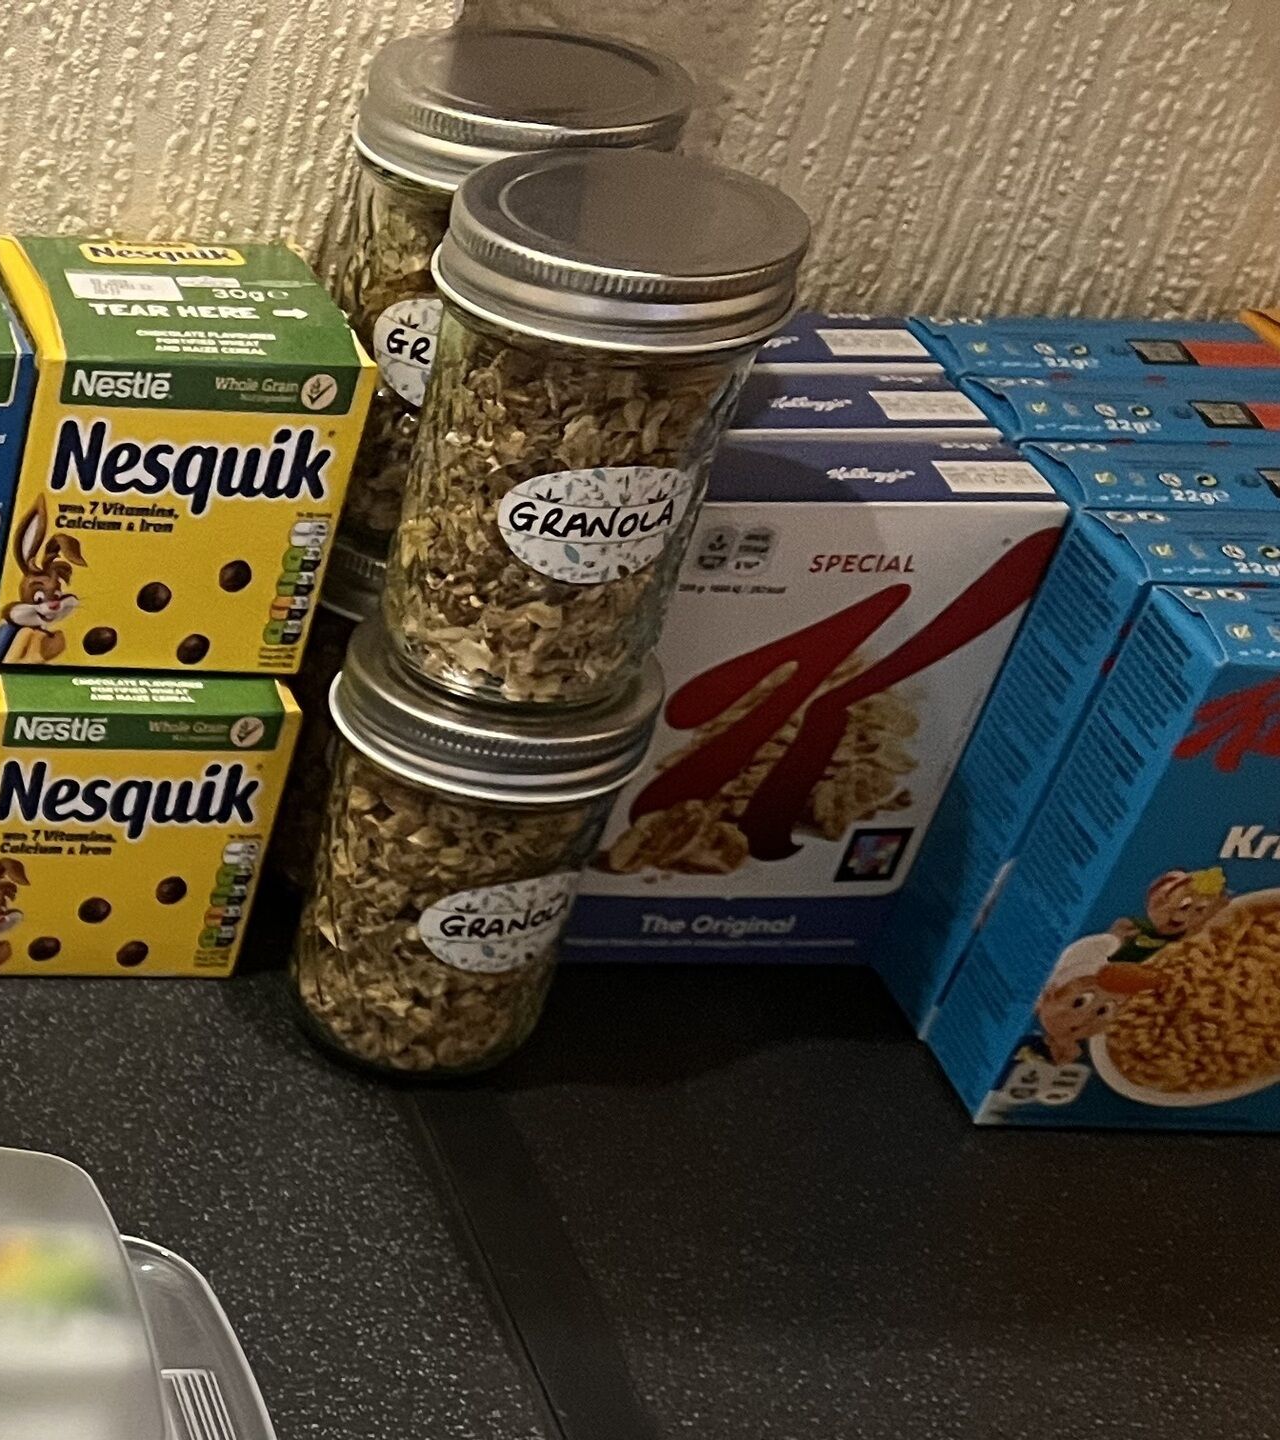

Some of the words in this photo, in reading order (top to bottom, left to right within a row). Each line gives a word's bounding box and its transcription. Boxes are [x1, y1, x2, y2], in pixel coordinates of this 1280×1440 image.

[86, 245, 239, 263] Nesquik
[212, 288, 266, 302] 30g
[88, 302, 171, 317] TEAR
[178, 305, 260, 320] HERE
[50, 420, 332, 515] Nesquik
[89, 501, 99, 514] 7
[510, 500, 674, 538] GRANOLA
[809, 554, 915, 573] SPECIAL
[642, 915, 686, 933] The
[692, 914, 797, 938] Original
